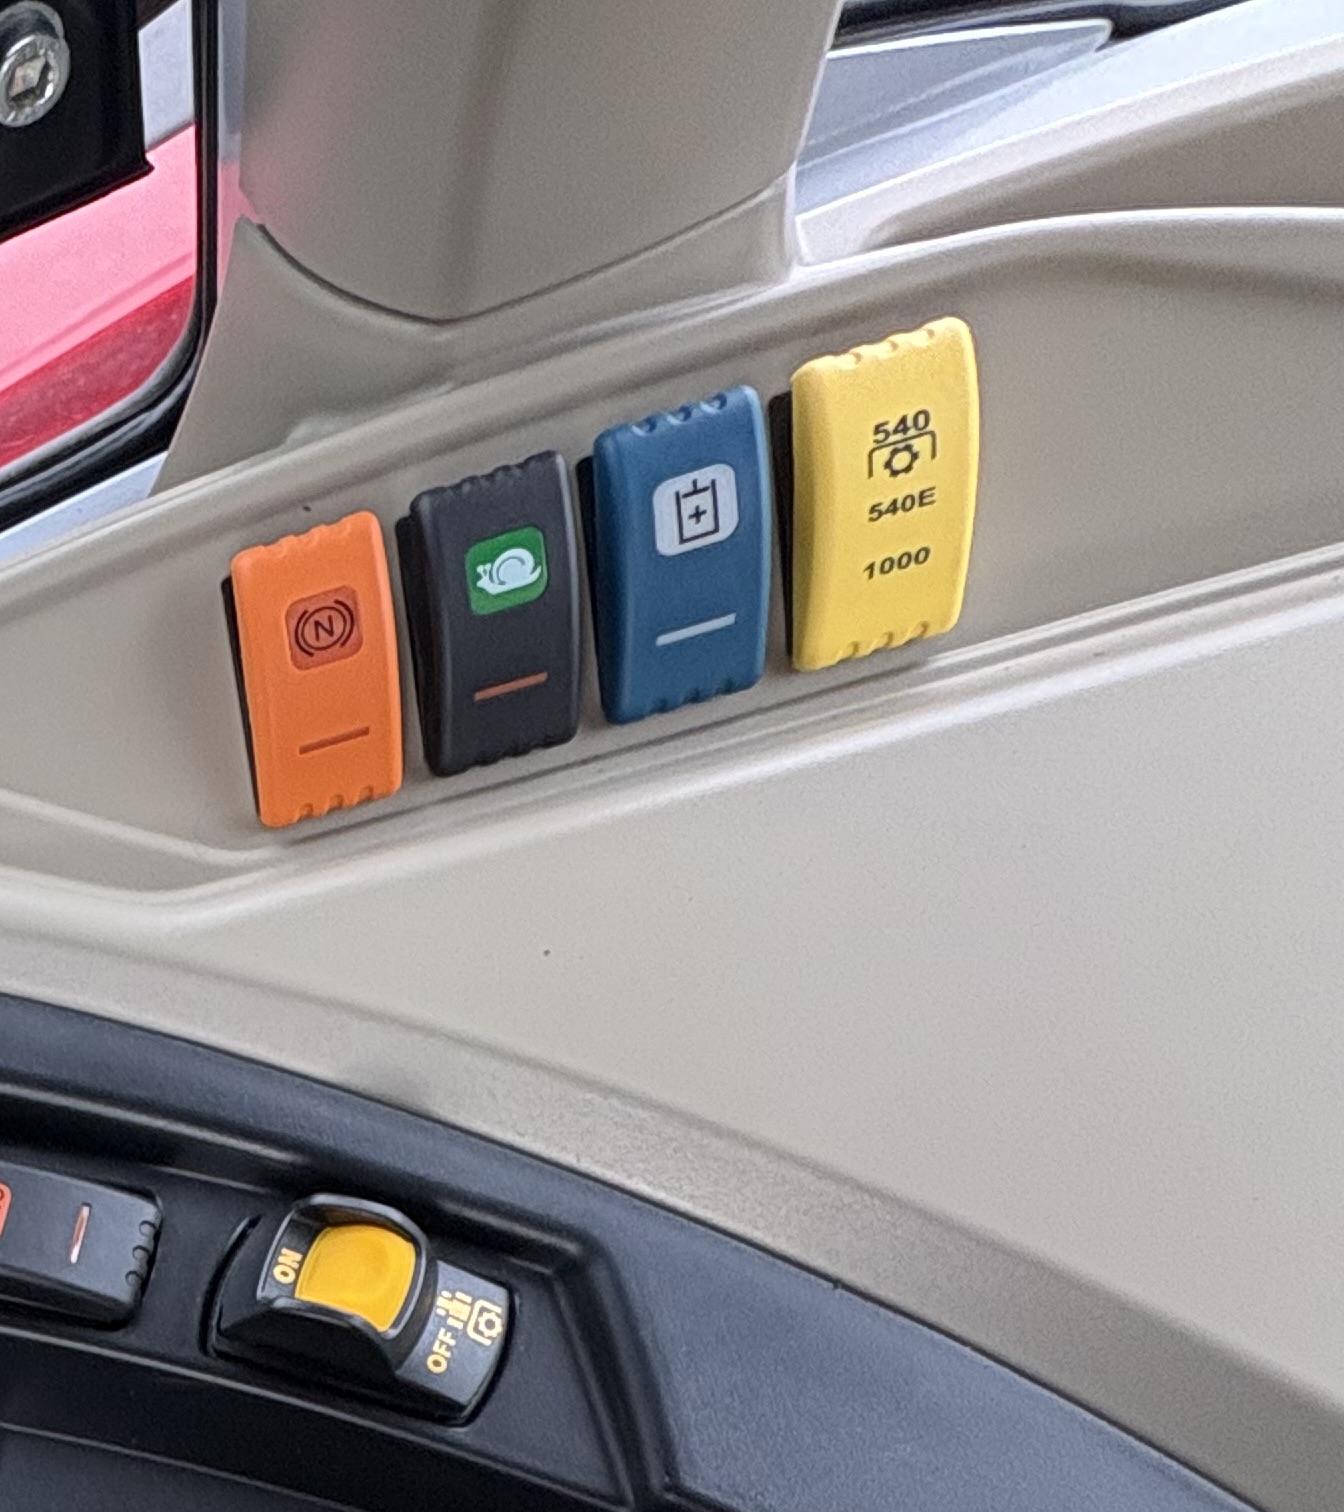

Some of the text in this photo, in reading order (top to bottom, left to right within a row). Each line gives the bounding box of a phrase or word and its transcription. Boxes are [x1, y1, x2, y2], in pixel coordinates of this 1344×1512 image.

[872, 409, 931, 444] 540
[868, 486, 937, 522] 540E
[862, 546, 931, 580] 1000
[314, 614, 334, 642] N
[273, 1247, 303, 1284] ON
[426, 1327, 457, 1374] OFF
